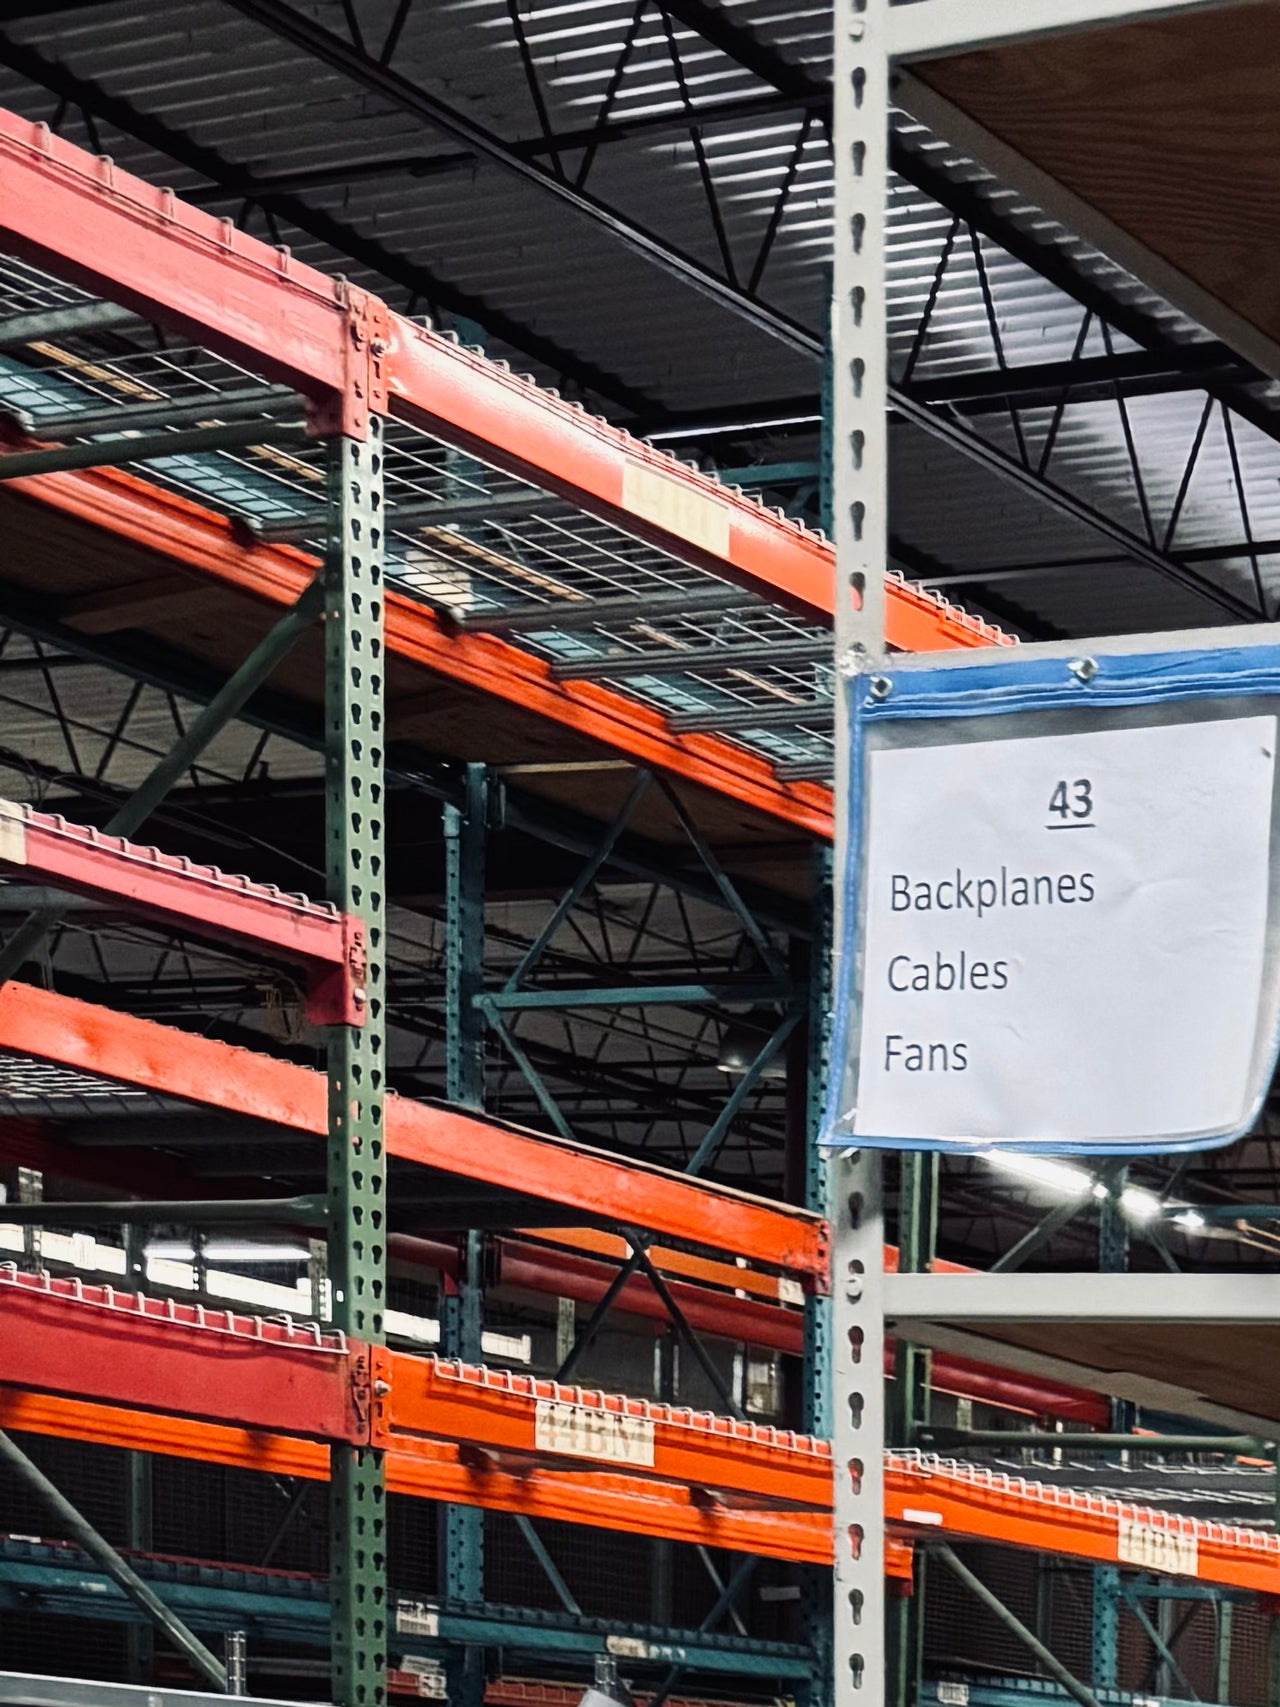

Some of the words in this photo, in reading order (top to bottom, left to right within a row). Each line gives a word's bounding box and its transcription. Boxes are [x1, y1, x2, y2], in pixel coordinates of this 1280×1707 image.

[1049, 779, 1093, 819] 43
[891, 866, 1095, 917] Backplanes
[888, 951, 1008, 991] Cables
[884, 1035, 968, 1072] Fans
